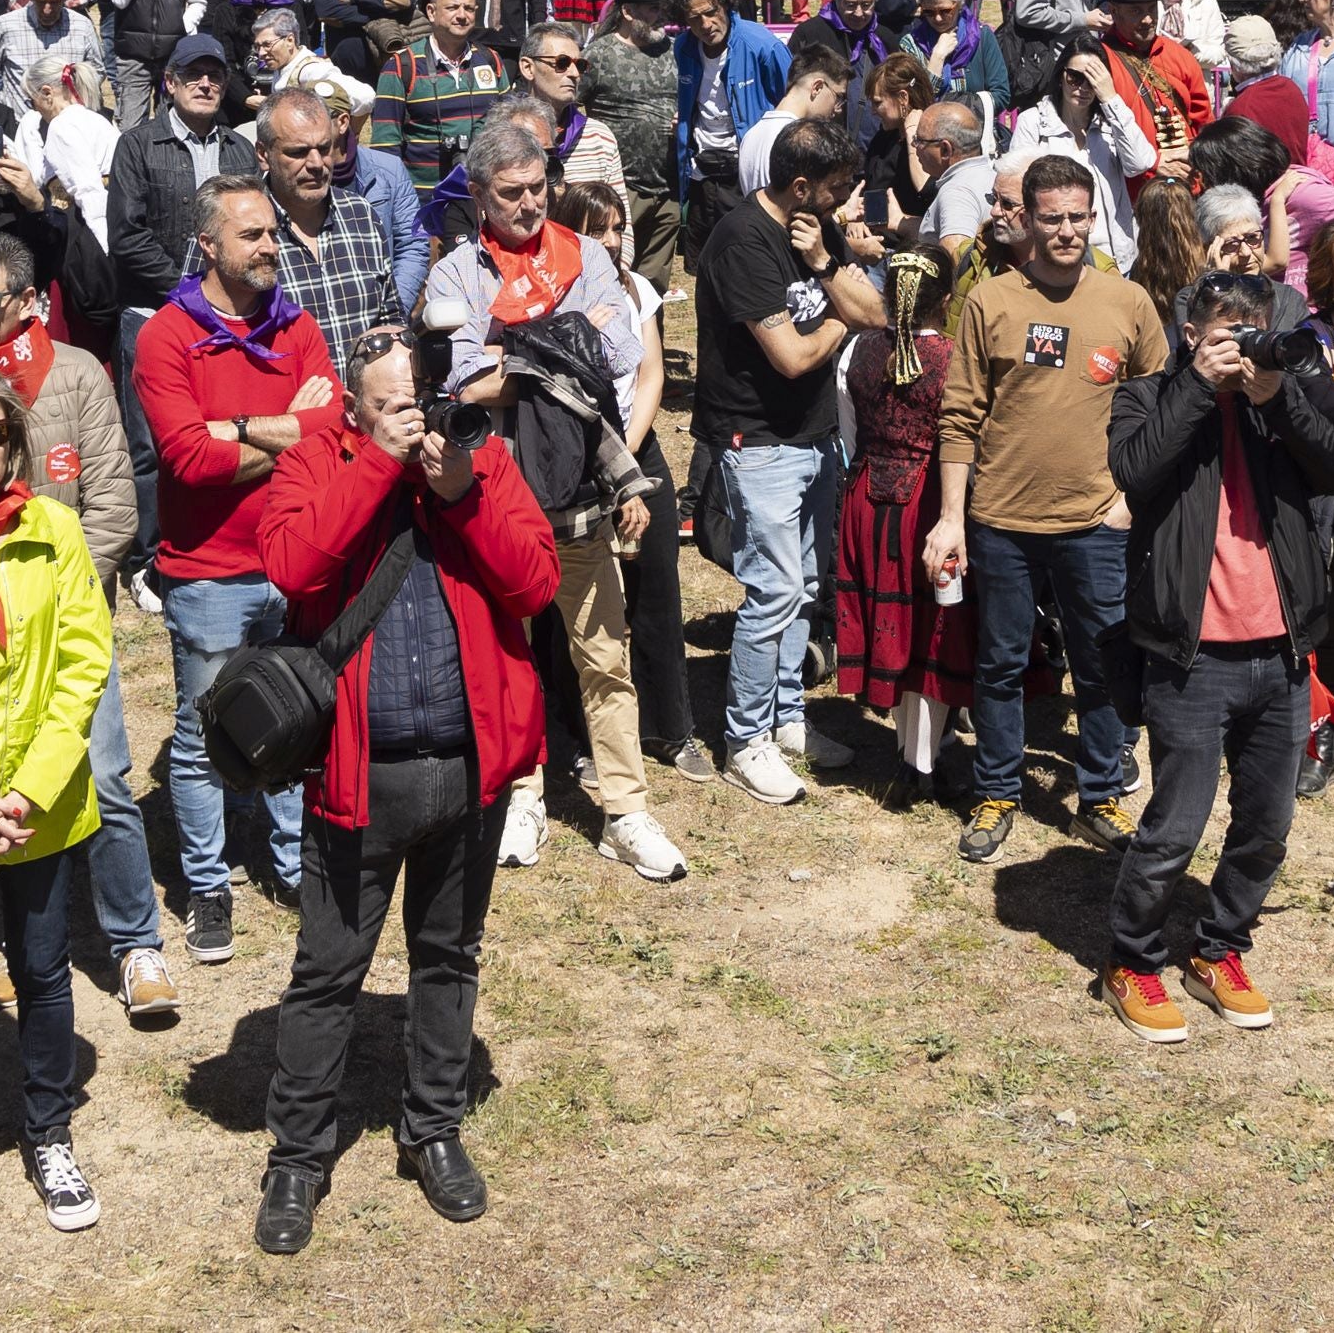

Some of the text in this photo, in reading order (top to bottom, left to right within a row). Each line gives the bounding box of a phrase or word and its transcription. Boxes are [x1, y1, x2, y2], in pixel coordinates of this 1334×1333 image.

[1033, 325, 1063, 335] ALTO EL
[1033, 331, 1063, 341] FUEGO
[1033, 337, 1061, 355] YA.
